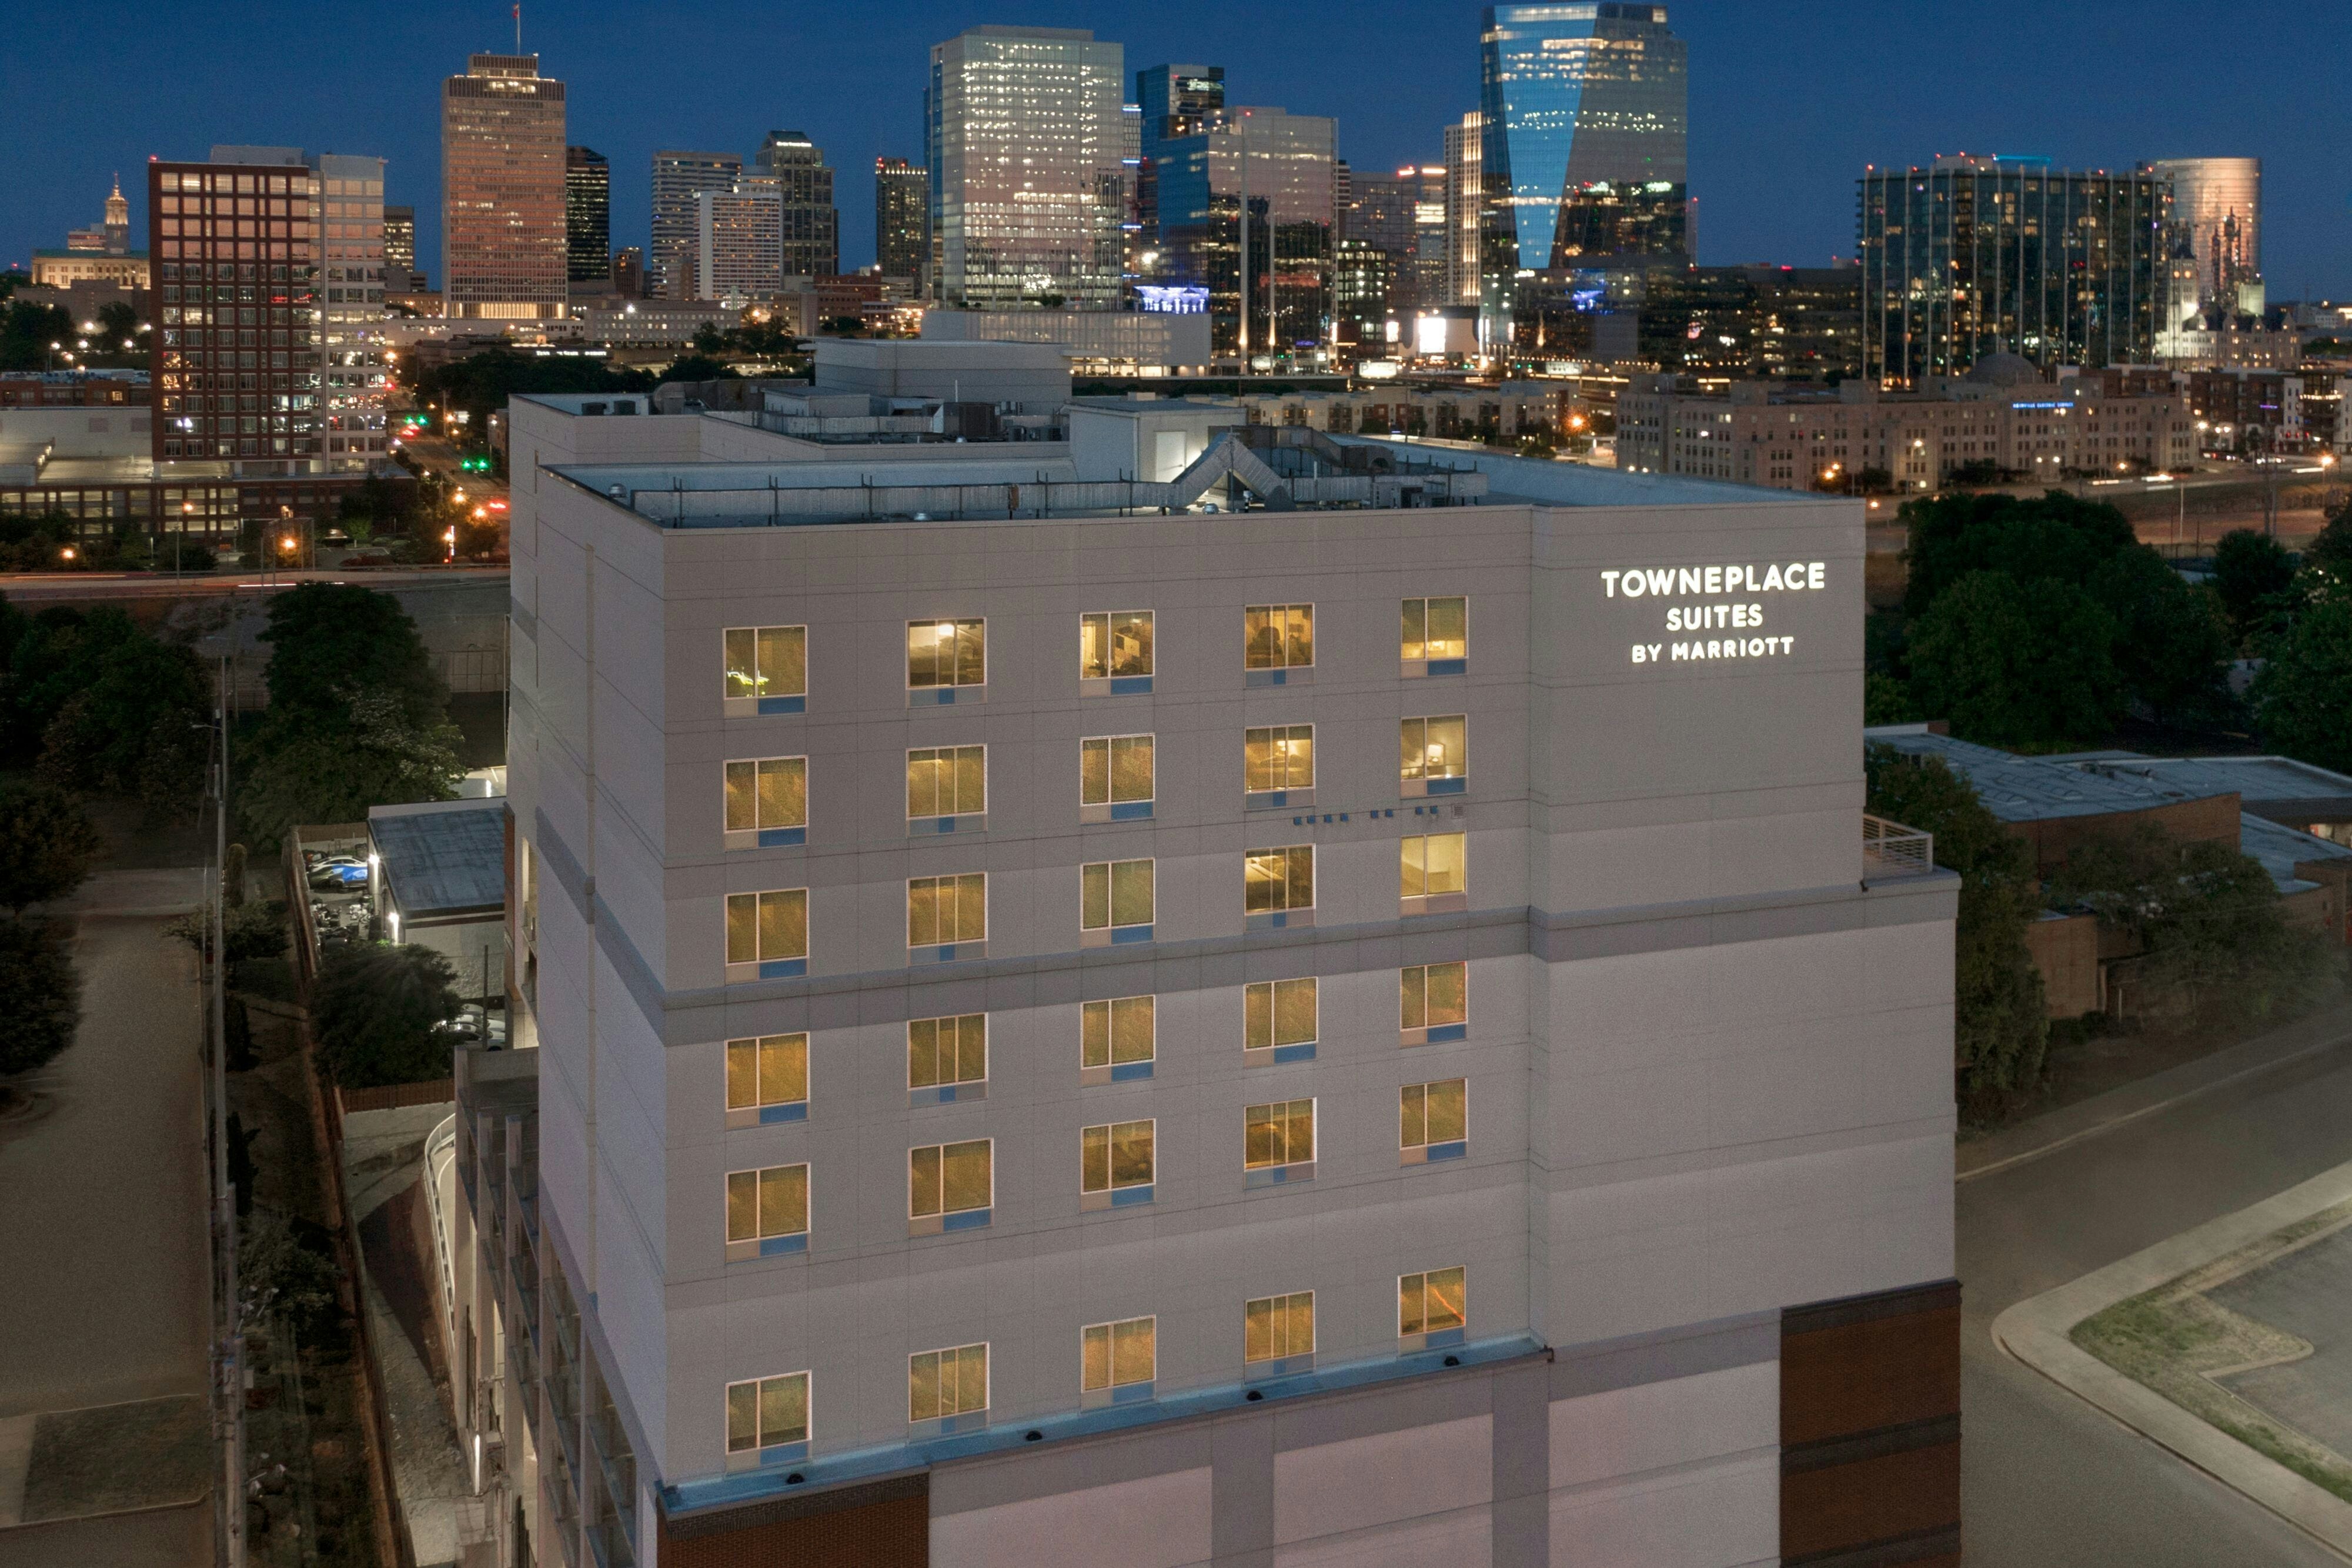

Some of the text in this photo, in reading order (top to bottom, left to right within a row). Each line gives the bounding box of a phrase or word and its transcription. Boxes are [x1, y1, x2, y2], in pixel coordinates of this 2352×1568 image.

[1601, 563, 1825, 597] TOWNEPLACE
[1666, 604, 1763, 631] SUITES
[1632, 636, 1794, 663] BY MARRIOTT
